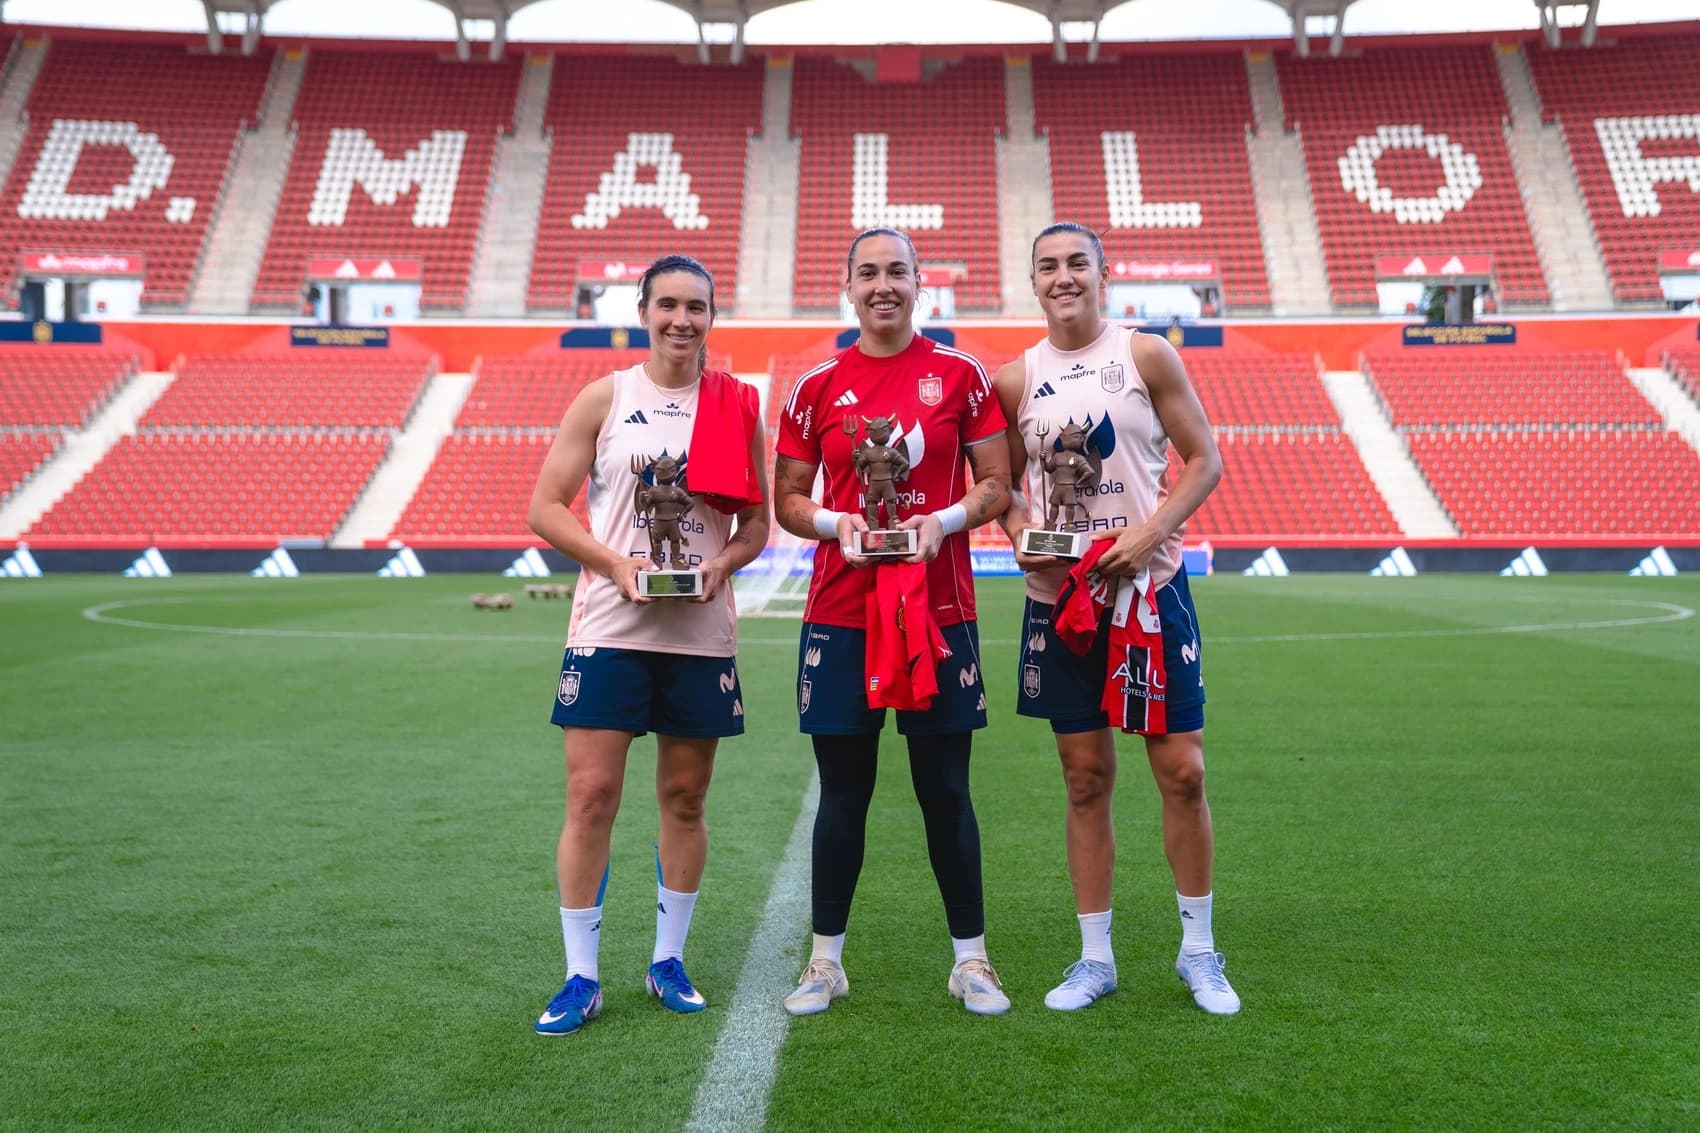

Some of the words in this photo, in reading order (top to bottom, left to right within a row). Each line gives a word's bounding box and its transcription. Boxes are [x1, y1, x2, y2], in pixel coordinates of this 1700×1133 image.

[17, 119, 196, 223] D.
[1060, 369, 1096, 381] mapfre
[653, 409, 692, 418] mapfre
[1120, 686, 1147, 698] HOTELS
